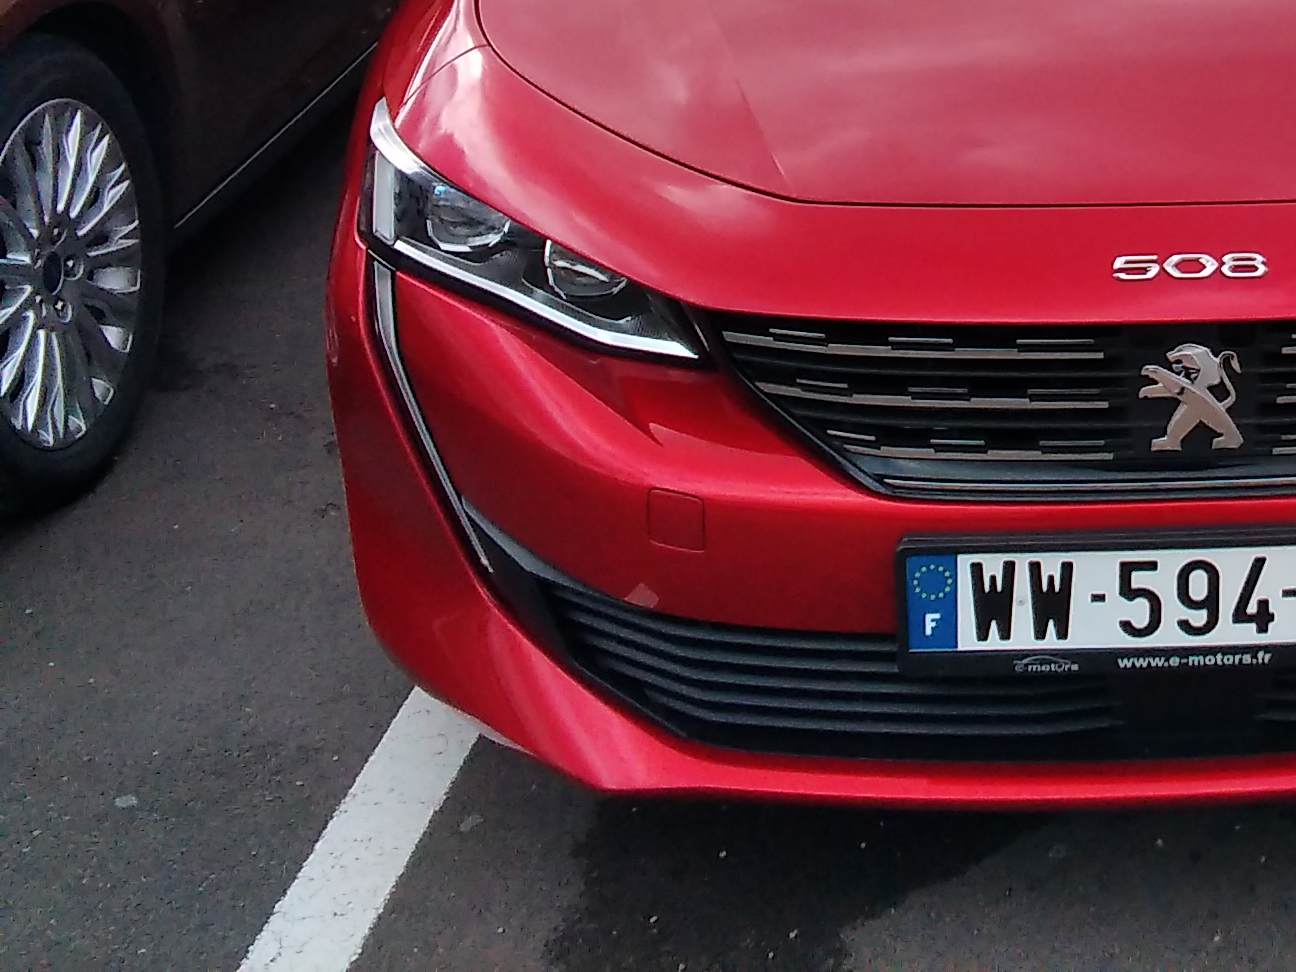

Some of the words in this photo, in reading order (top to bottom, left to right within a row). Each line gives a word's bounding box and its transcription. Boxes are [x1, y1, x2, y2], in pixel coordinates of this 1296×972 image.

[1112, 252, 1269, 280] 508
[924, 612, 942, 637] F
[1117, 650, 1273, 669] www.e-motors.fr
